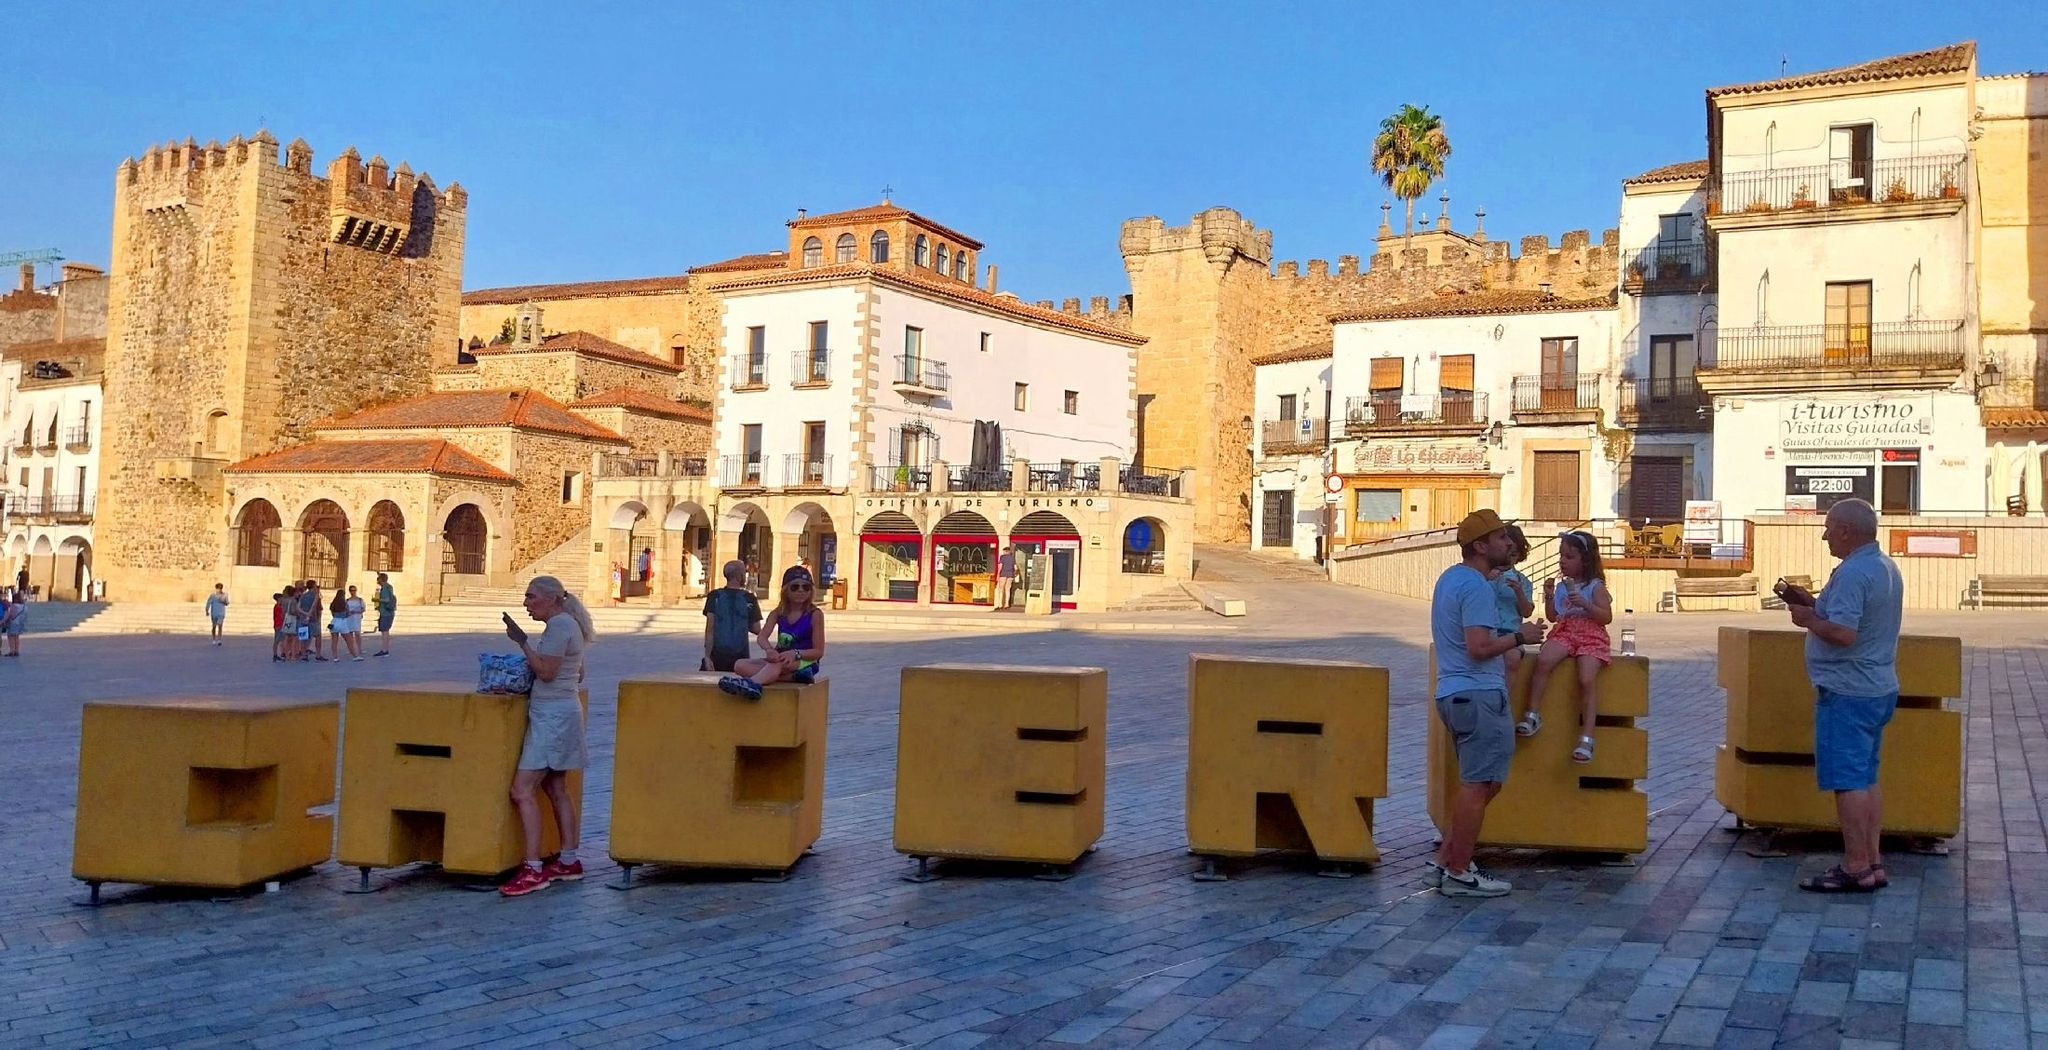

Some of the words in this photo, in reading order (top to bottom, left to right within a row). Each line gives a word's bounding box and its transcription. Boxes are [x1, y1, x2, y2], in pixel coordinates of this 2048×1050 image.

[1791, 402, 1914, 420] i-turismo
[1782, 420, 1843, 434] Visitas
[1846, 420, 1920, 437] Guiadas
[1859, 437, 1871, 446] de
[1873, 437, 1918, 447] Turismo
[1810, 479, 1852, 491] 22:00
[866, 499, 941, 508] OFICINA
[966, 499, 983, 507] DE
[1006, 498, 1094, 508] TURISMO
